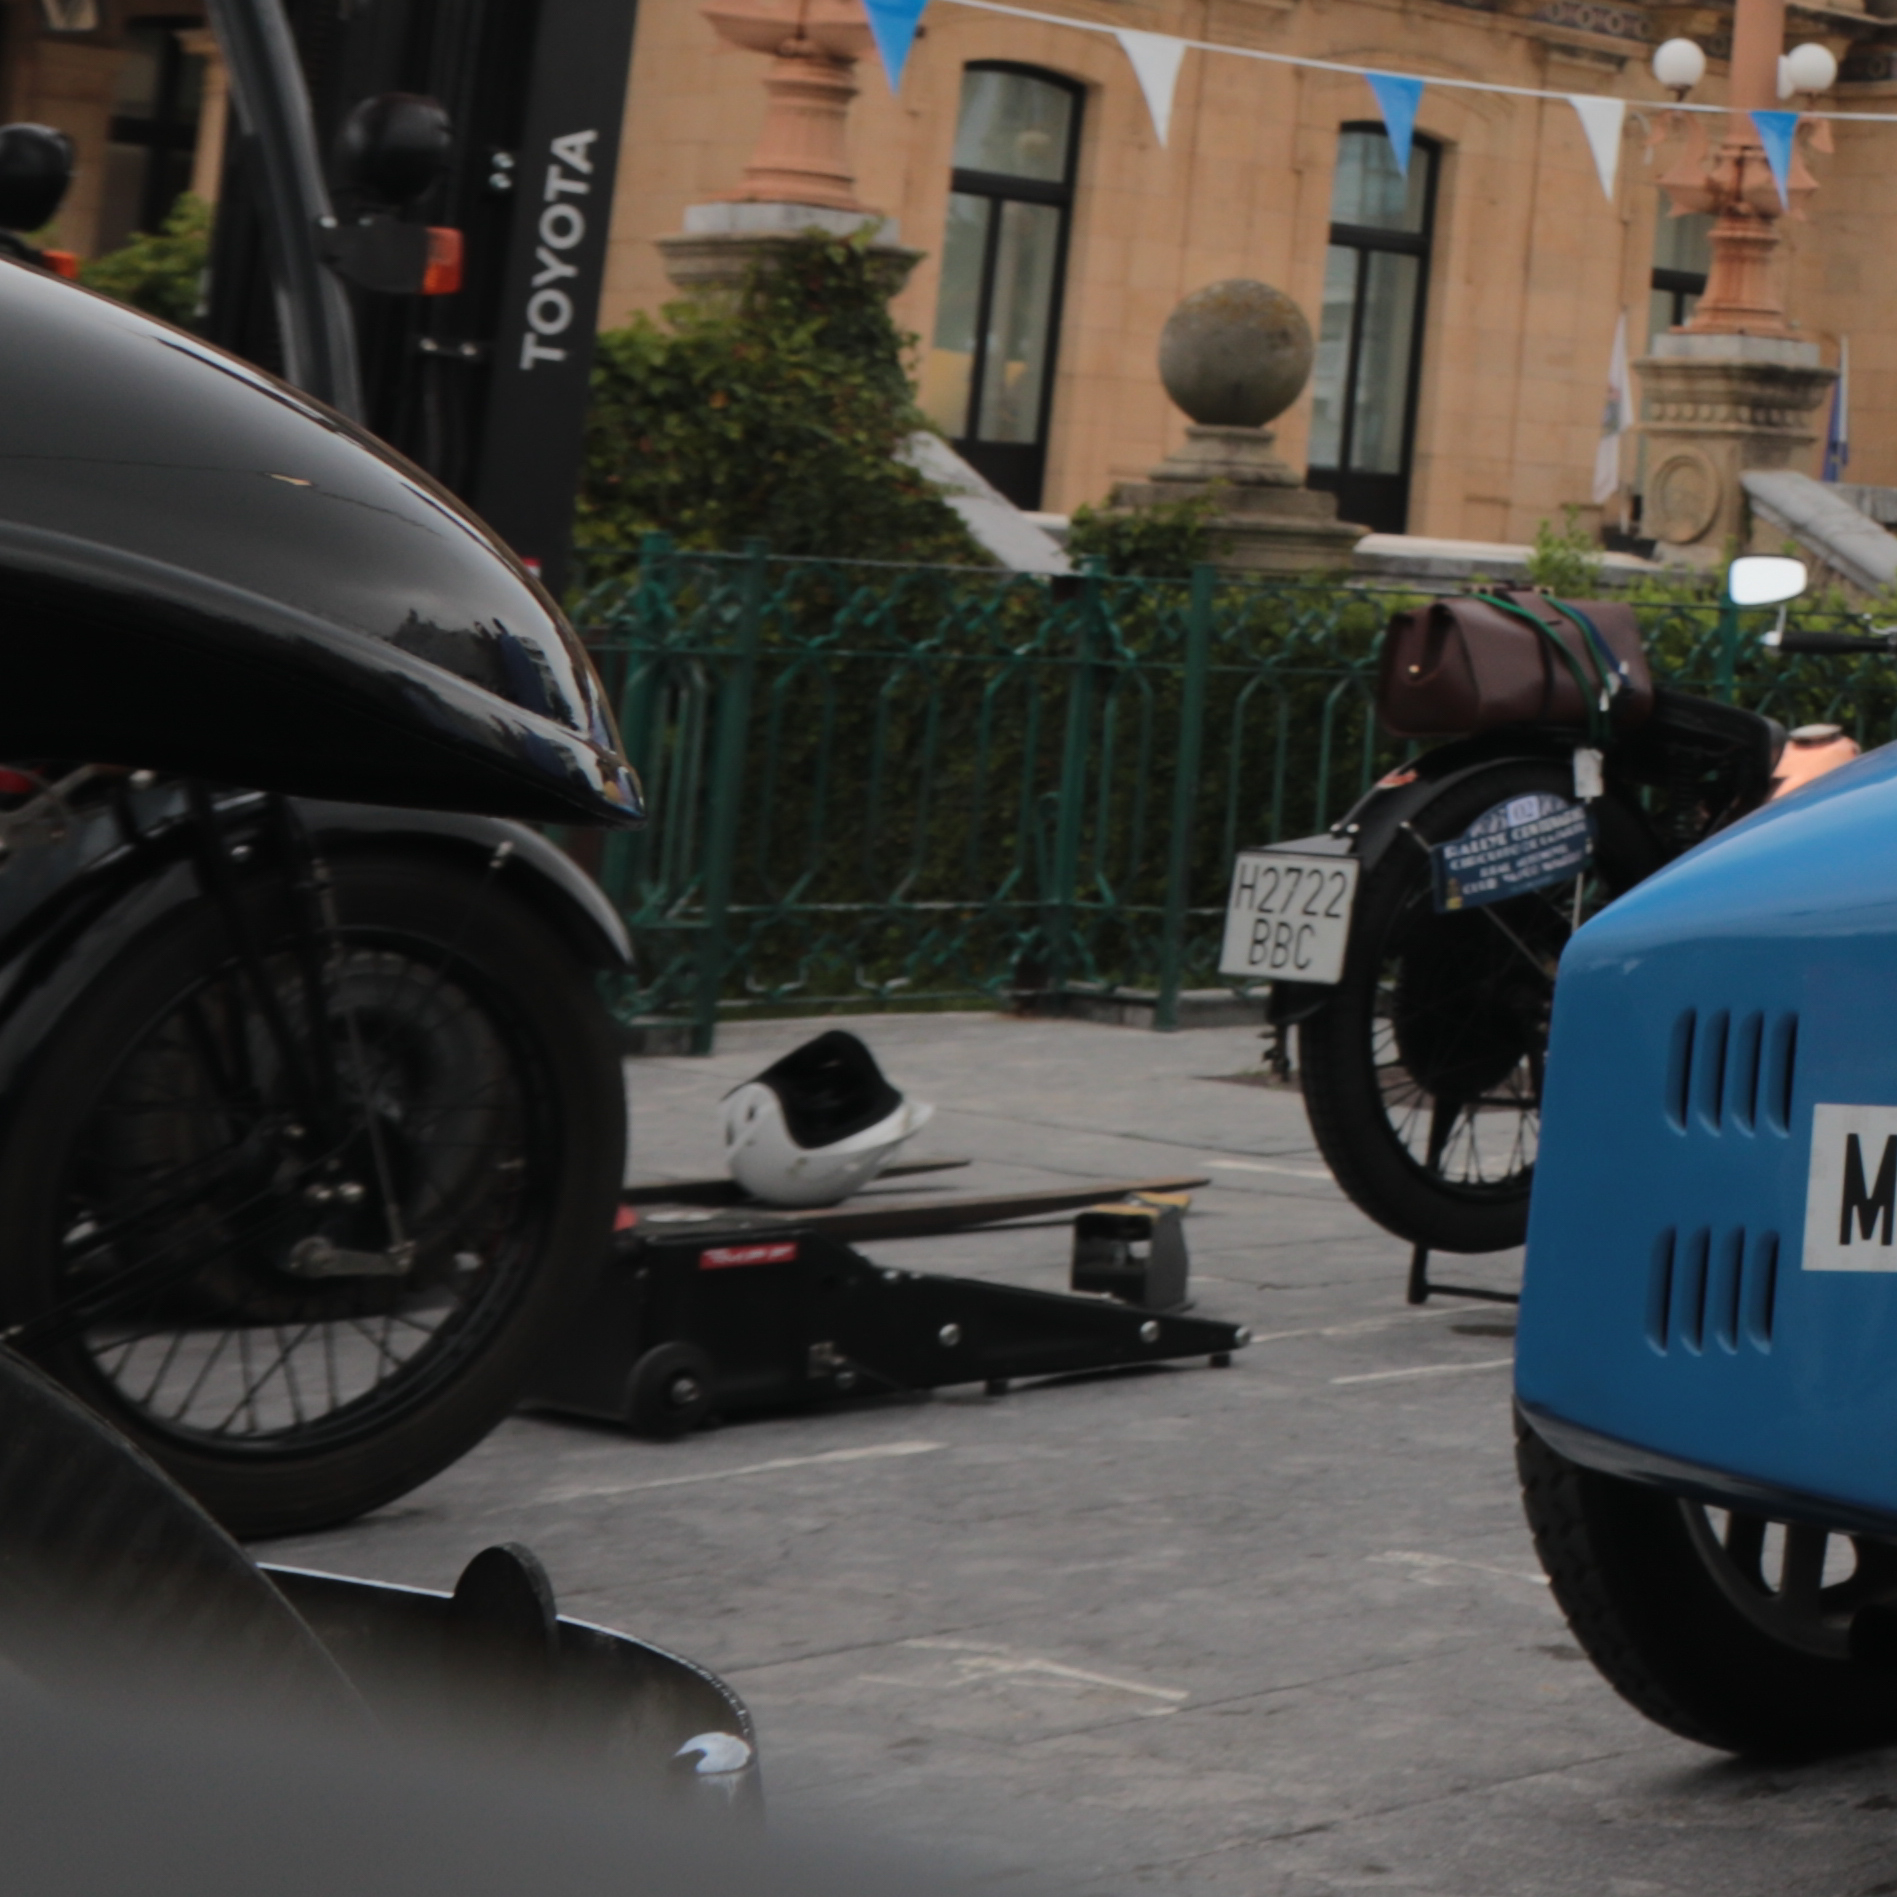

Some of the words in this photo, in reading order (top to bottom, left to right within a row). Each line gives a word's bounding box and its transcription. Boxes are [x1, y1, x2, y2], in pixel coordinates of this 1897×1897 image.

[519, 129, 599, 370] TOYOTA
[1235, 864, 1347, 918] H2722
[1248, 918, 1316, 970] BBC
